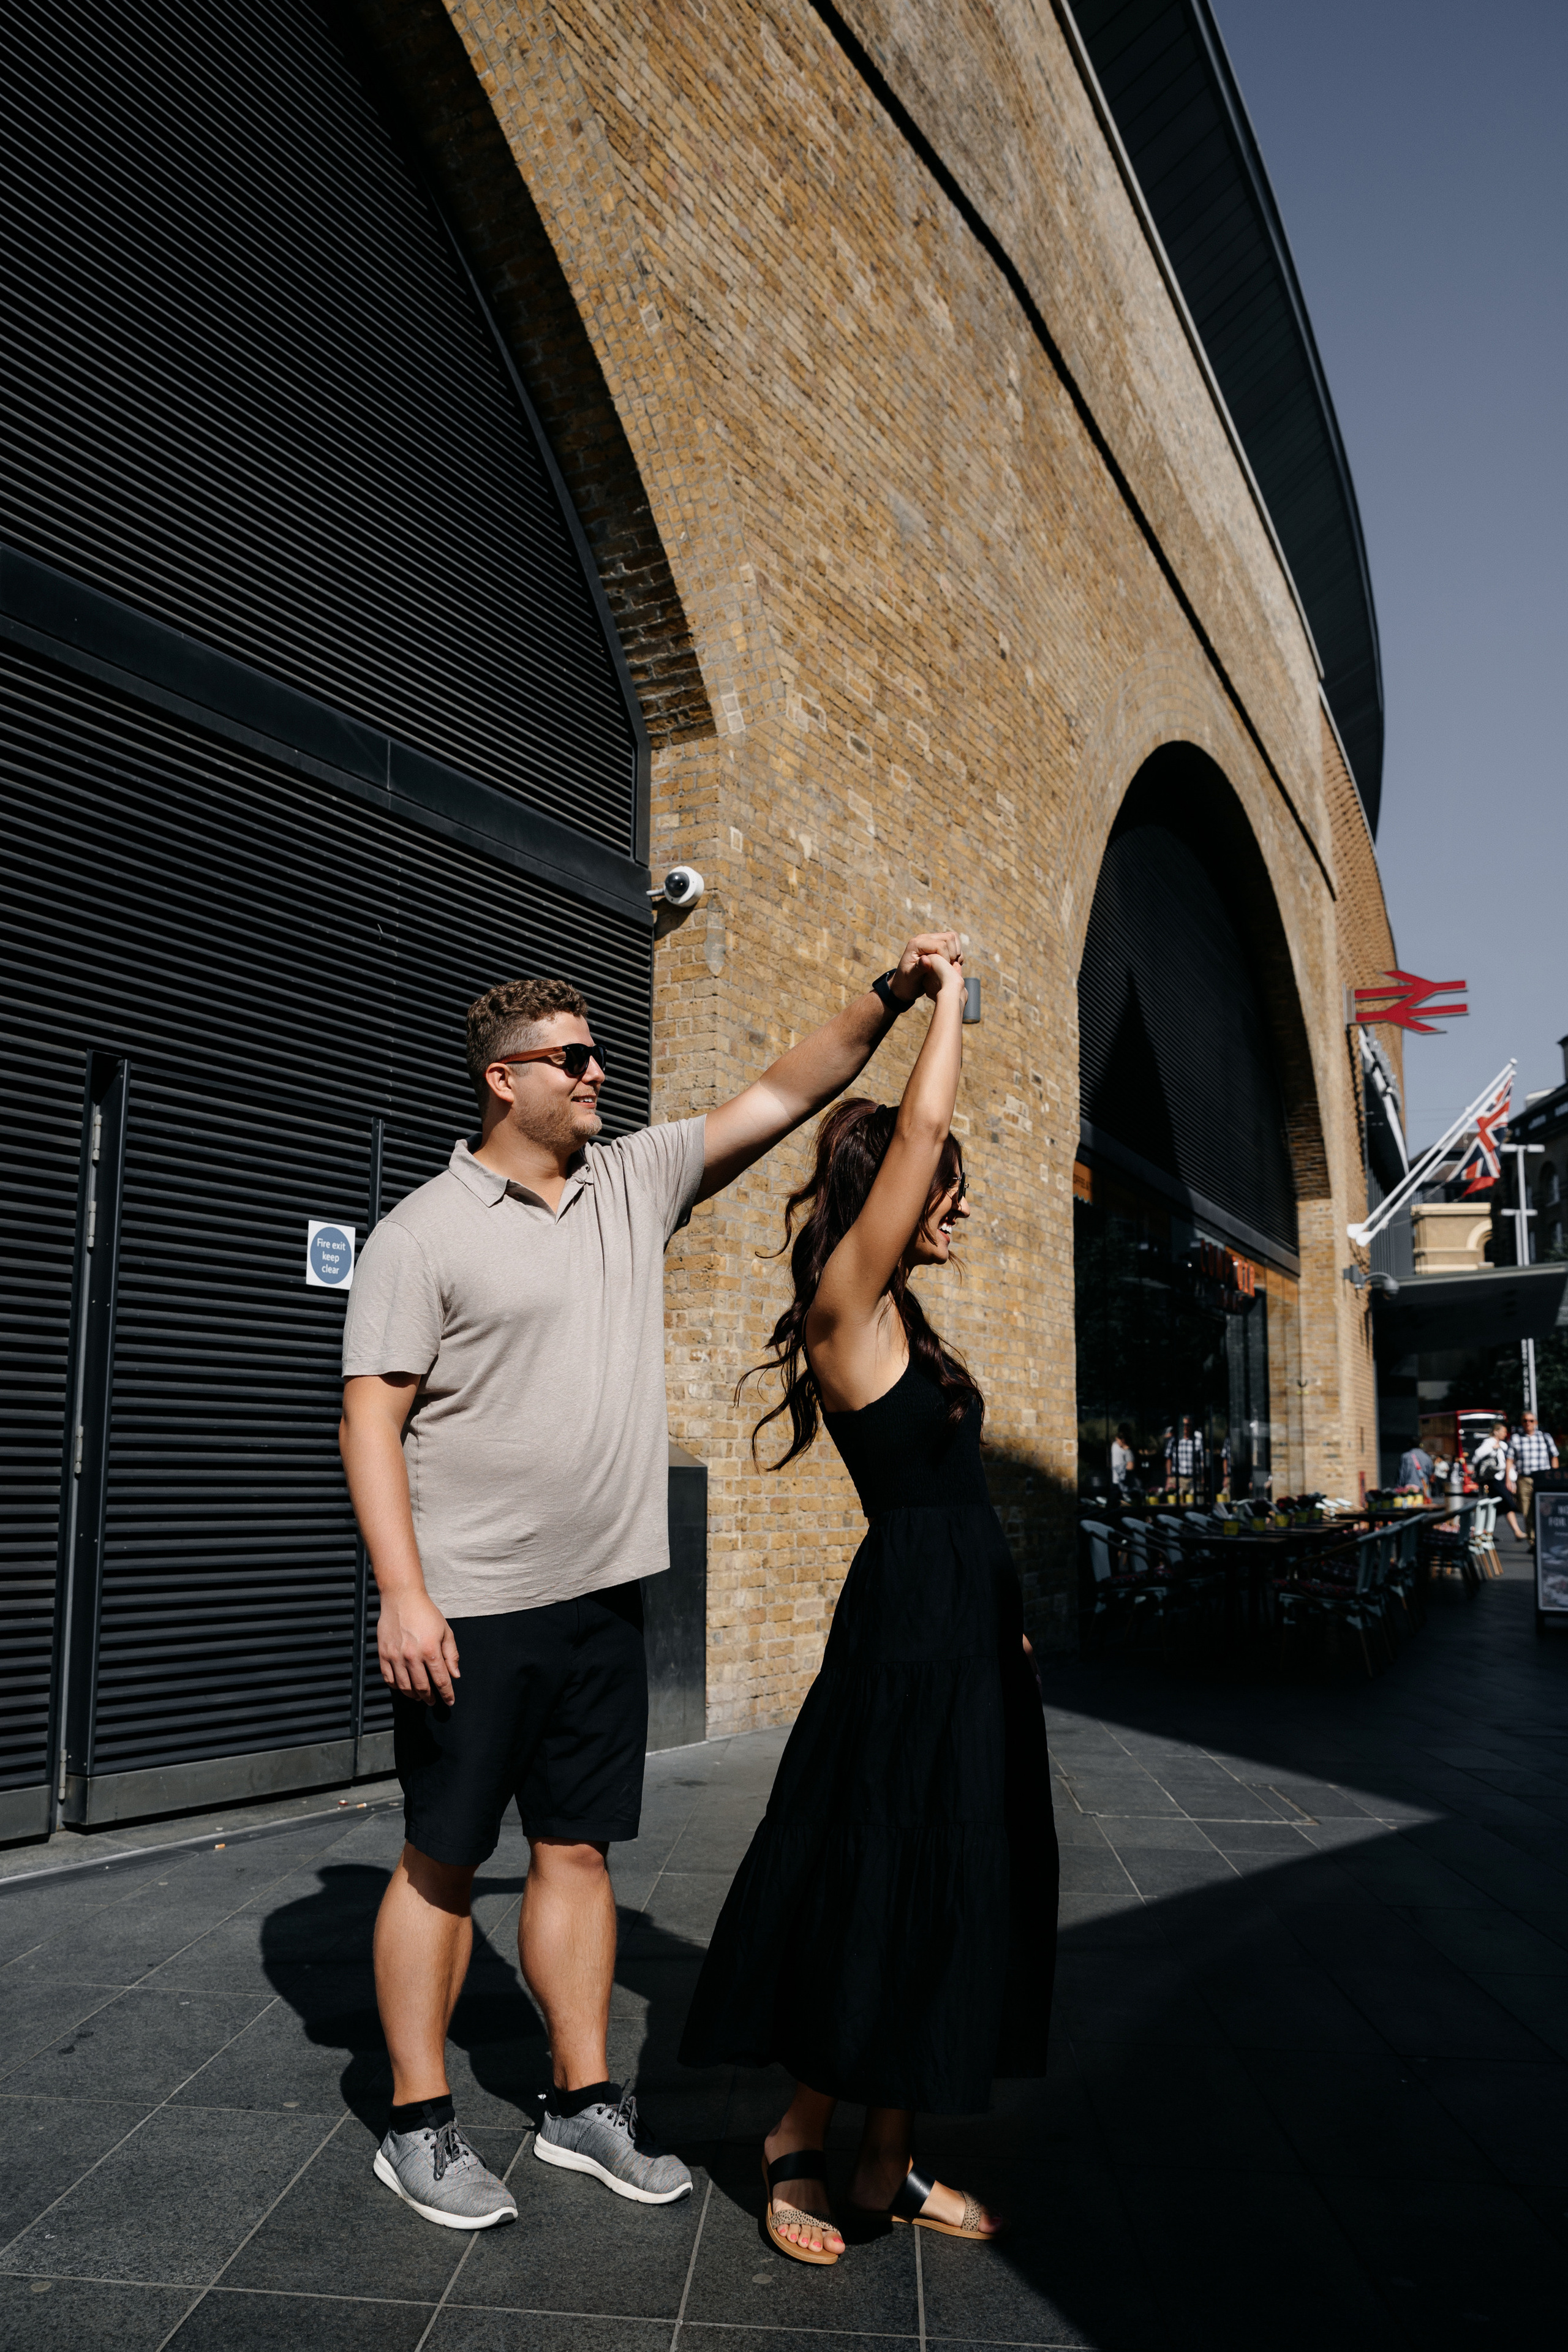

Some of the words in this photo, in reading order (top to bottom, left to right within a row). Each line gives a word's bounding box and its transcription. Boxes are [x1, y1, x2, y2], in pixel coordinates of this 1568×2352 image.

[317, 1238, 330, 1248] Fire
[332, 1242, 346, 1251] exit
[322, 1251, 339, 1264] keep
[322, 1264, 339, 1274] clear
